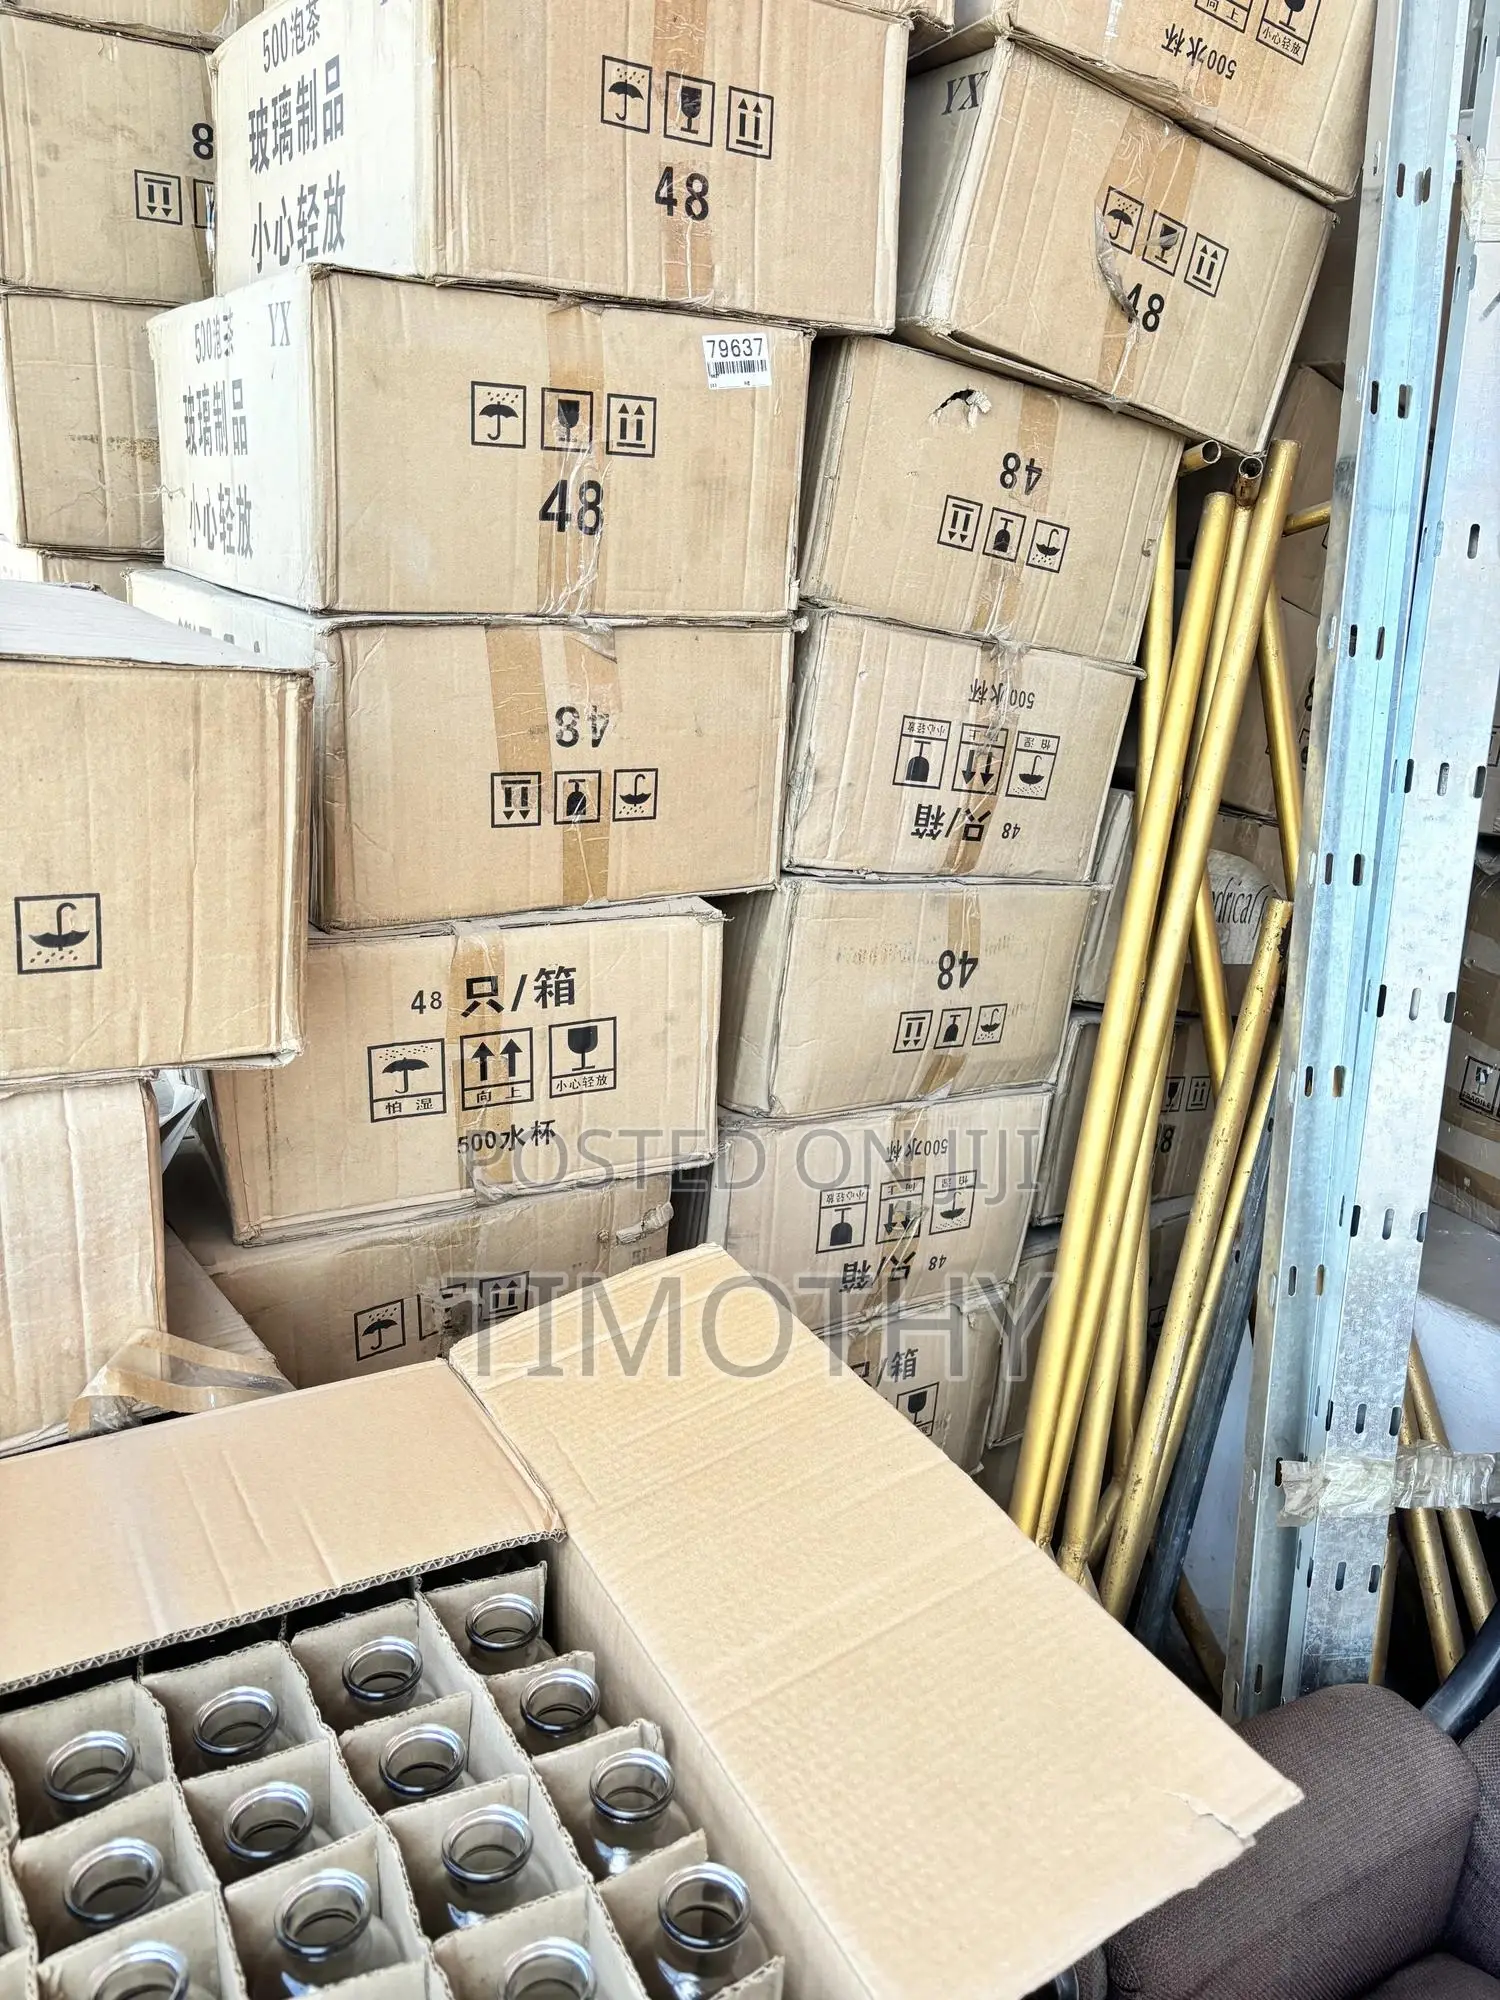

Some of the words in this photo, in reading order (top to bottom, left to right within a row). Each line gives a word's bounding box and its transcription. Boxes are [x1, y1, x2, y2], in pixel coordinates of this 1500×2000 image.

[263, 0, 320, 73] 500泡茶
[1161, 23, 1237, 80] 500水杯
[1262, 26, 1302, 57] 小心轻放
[249, 54, 344, 174] 玻璃制品
[941, 71, 988, 115] YX
[192, 123, 213, 160] 8
[654, 166, 711, 221] 48
[251, 169, 346, 274] 小心轻放
[268, 301, 292, 346] YX
[1121, 283, 1165, 332] 48
[706, 338, 763, 358] 79637
[182, 379, 249, 457] 玻璃制品
[999, 452, 1043, 495] 48
[189, 483, 254, 559] 小心轻放
[538, 479, 604, 535] 48
[911, 803, 992, 842] 只/箱
[1001, 822, 1021, 839] 48
[937, 949, 979, 990] 48
[411, 989, 443, 1014] 48
[461, 966, 577, 1018] 只/箱
[477, 1086, 522, 1104] 向上
[556, 1074, 608, 1092] 小心轻放
[385, 1097, 434, 1115] 怕湿
[457, 1119, 556, 1154] 500水杯
[1157, 1123, 1176, 1153] 8
[928, 1254, 947, 1271] 48
